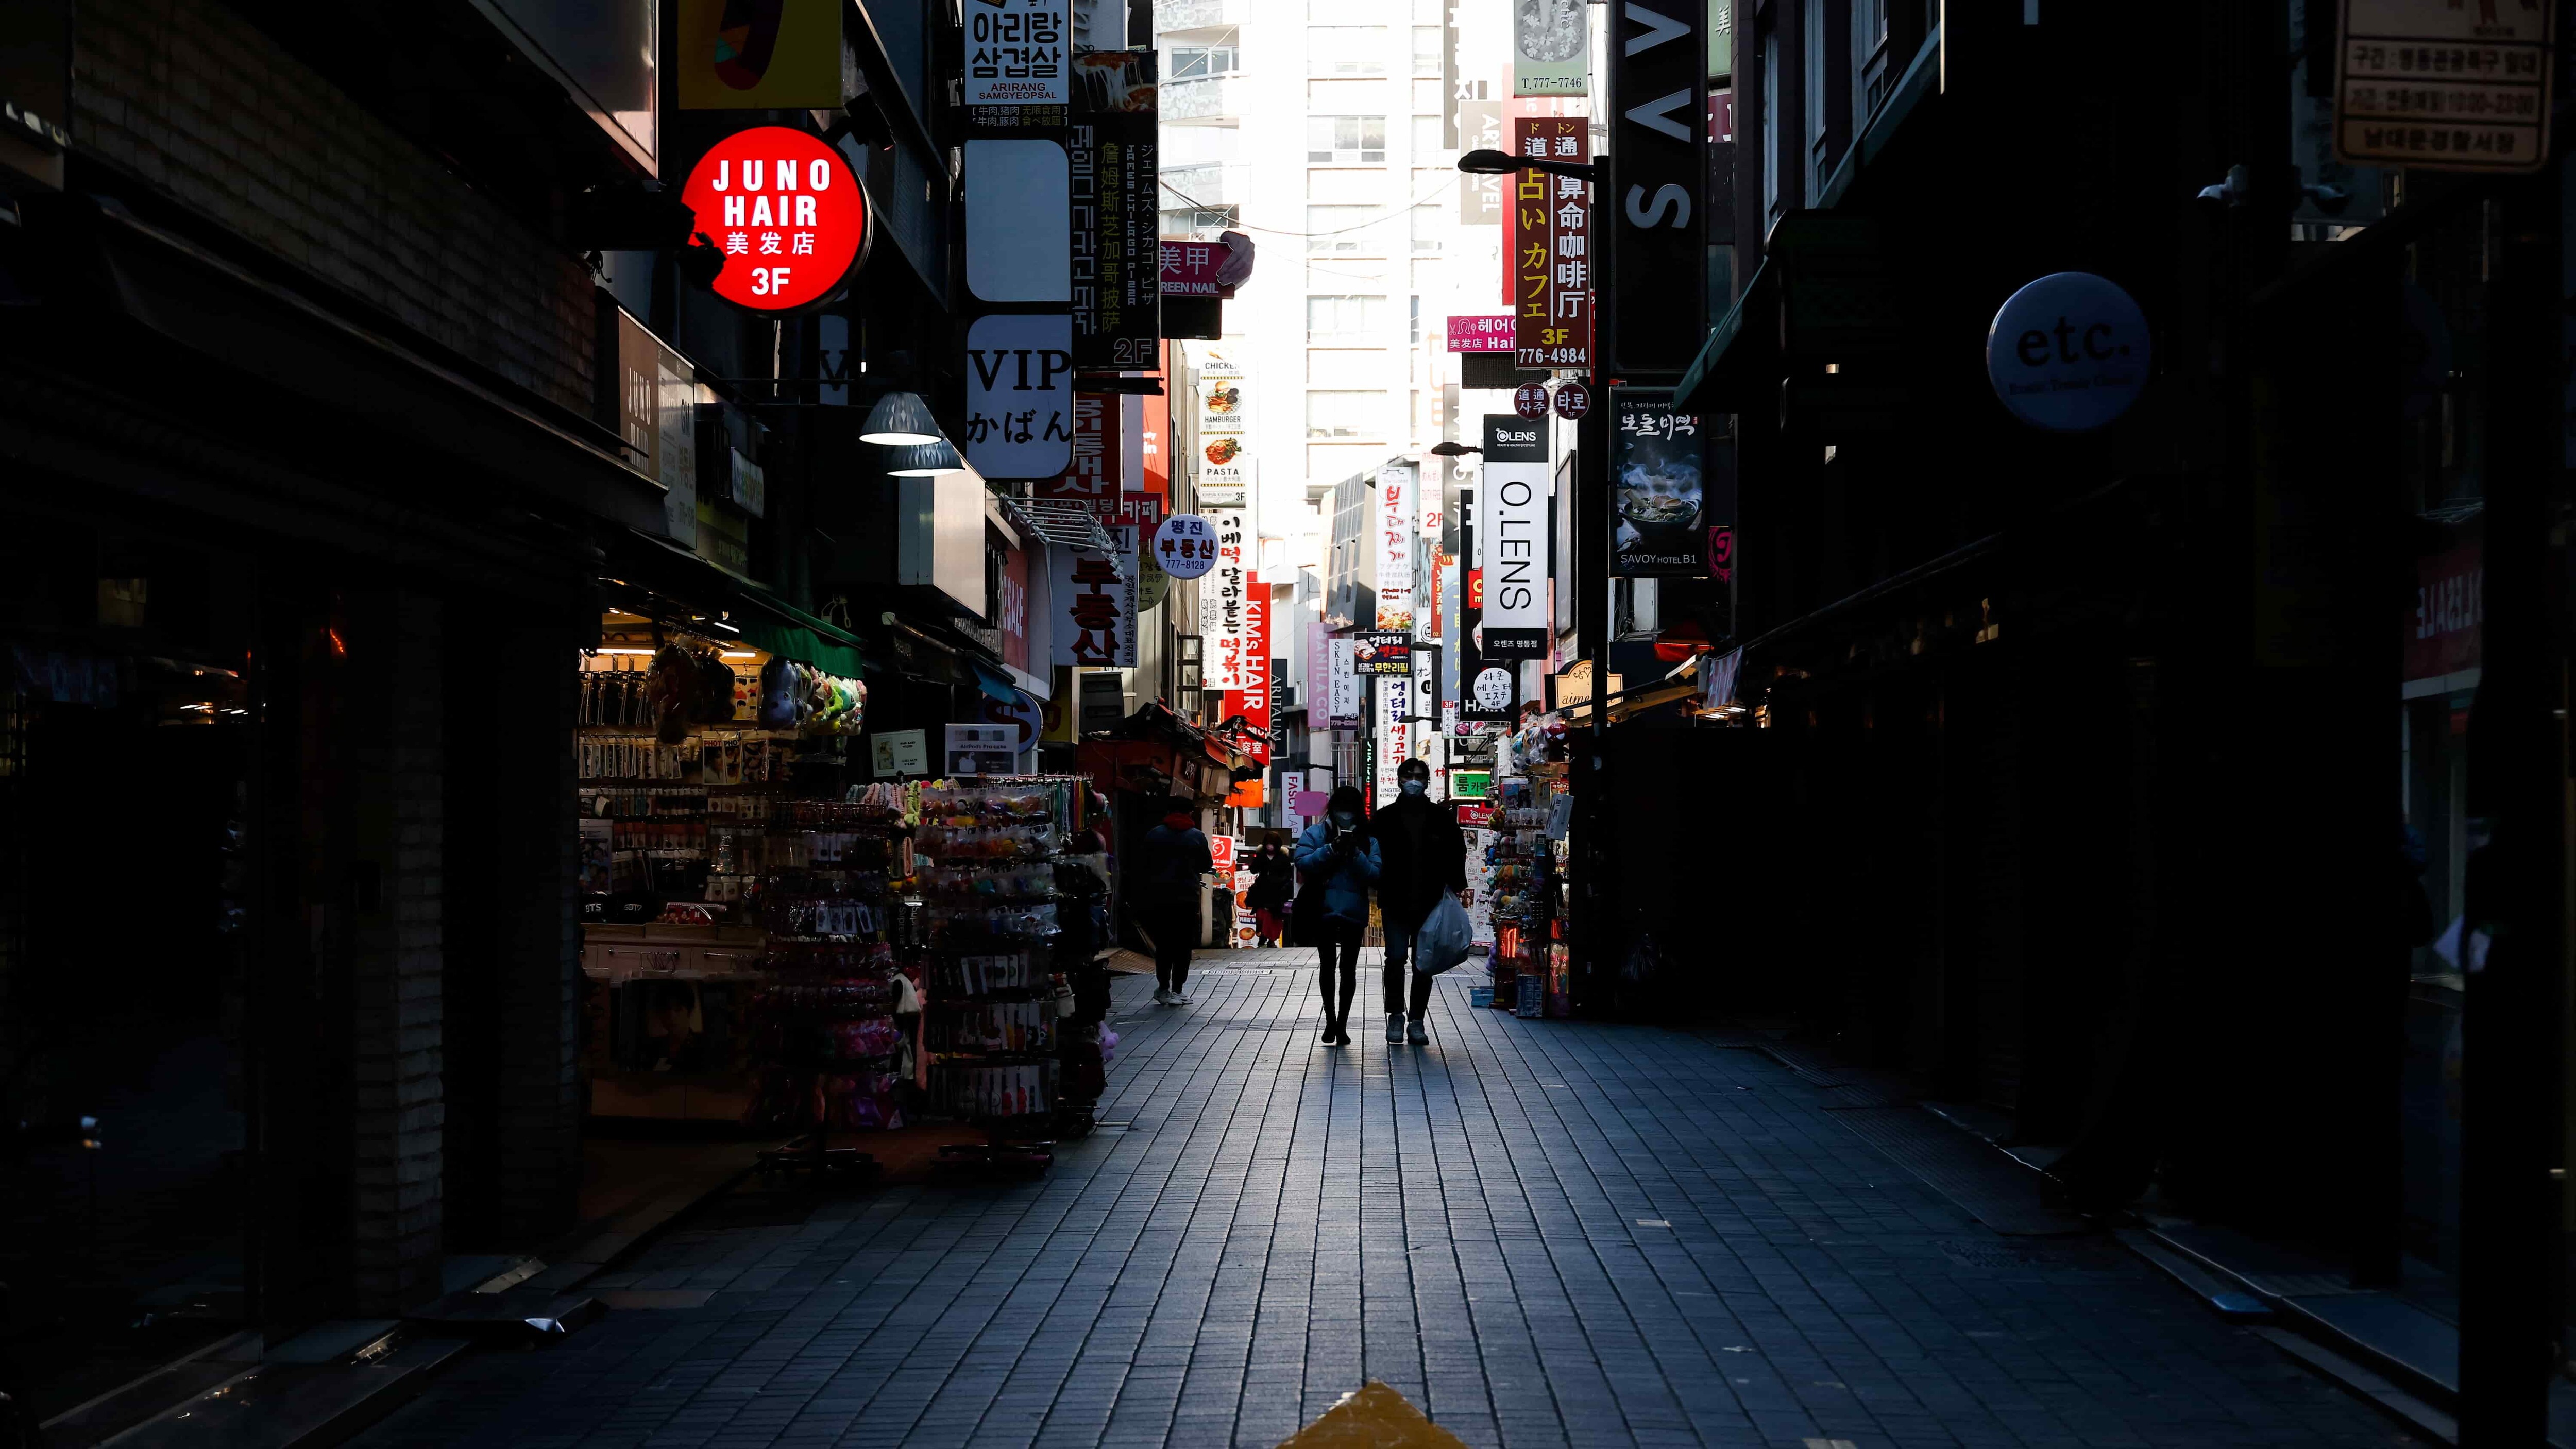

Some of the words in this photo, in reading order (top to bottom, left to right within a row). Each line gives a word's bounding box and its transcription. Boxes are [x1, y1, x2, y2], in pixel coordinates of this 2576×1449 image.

[973, 12, 1062, 44] 아리랑
[972, 46, 1061, 78] 삼겹살
[991, 82, 1046, 92] ARIRANG
[1521, 77, 1582, 90] T.777-7746
[979, 92, 1057, 100] SAMGYEOPSAL
[1126, 144, 1136, 189] JAMES
[1481, 113, 1500, 213] ARTVEL
[713, 159, 831, 192] JUNO
[723, 195, 818, 227] HAIR
[1127, 194, 1136, 257] CHICAGO
[726, 232, 815, 255] 美发店
[1557, 173, 1587, 319] 算命咖啡厅
[1160, 246, 1209, 275] 美甲
[751, 267, 791, 295] 3F
[1161, 282, 1190, 293] REEN
[1192, 283, 1219, 294] NAIL
[1449, 338, 1483, 349] 美发店
[1487, 337, 1515, 349] Hai
[1541, 328, 1569, 345] 3F
[2017, 315, 2130, 367] etc.
[1113, 337, 1153, 364] 2F
[1519, 347, 1586, 363] 776-4984
[967, 350, 1071, 391] VIP
[1205, 362, 1240, 370] CHICKE
[628, 367, 651, 426] JUNO
[1519, 401, 1546, 414] 사주
[1557, 391, 1586, 411] 타로
[966, 408, 1071, 445] かばん
[1205, 415, 1241, 423] HAMBURGER
[1235, 492, 1246, 501] 3F
[1171, 520, 1203, 536] 명진
[1160, 538, 1215, 560] 부동산
[1498, 481, 1532, 610] O.LENS
[1165, 559, 1205, 570] 777-8128
[1620, 554, 1656, 564] SAVOY
[1682, 554, 1697, 564] B1
[1069, 557, 1122, 666] 부동산
[1246, 600, 1264, 651] KIM's
[1369, 636, 1403, 647] 엉터리
[1378, 646, 1409, 658] 생고기
[1316, 630, 1328, 693] BANILA
[1375, 662, 1409, 673] 무한리필
[1243, 655, 1264, 711] HAIR
[1271, 674, 1282, 741] ARITAUM
[1316, 697, 1328, 720] CO
[1242, 741, 1262, 754] 容室
[1390, 724, 1406, 764] 생고기
[1456, 776, 1469, 792] 룸
[1471, 781, 1488, 792] 카페
